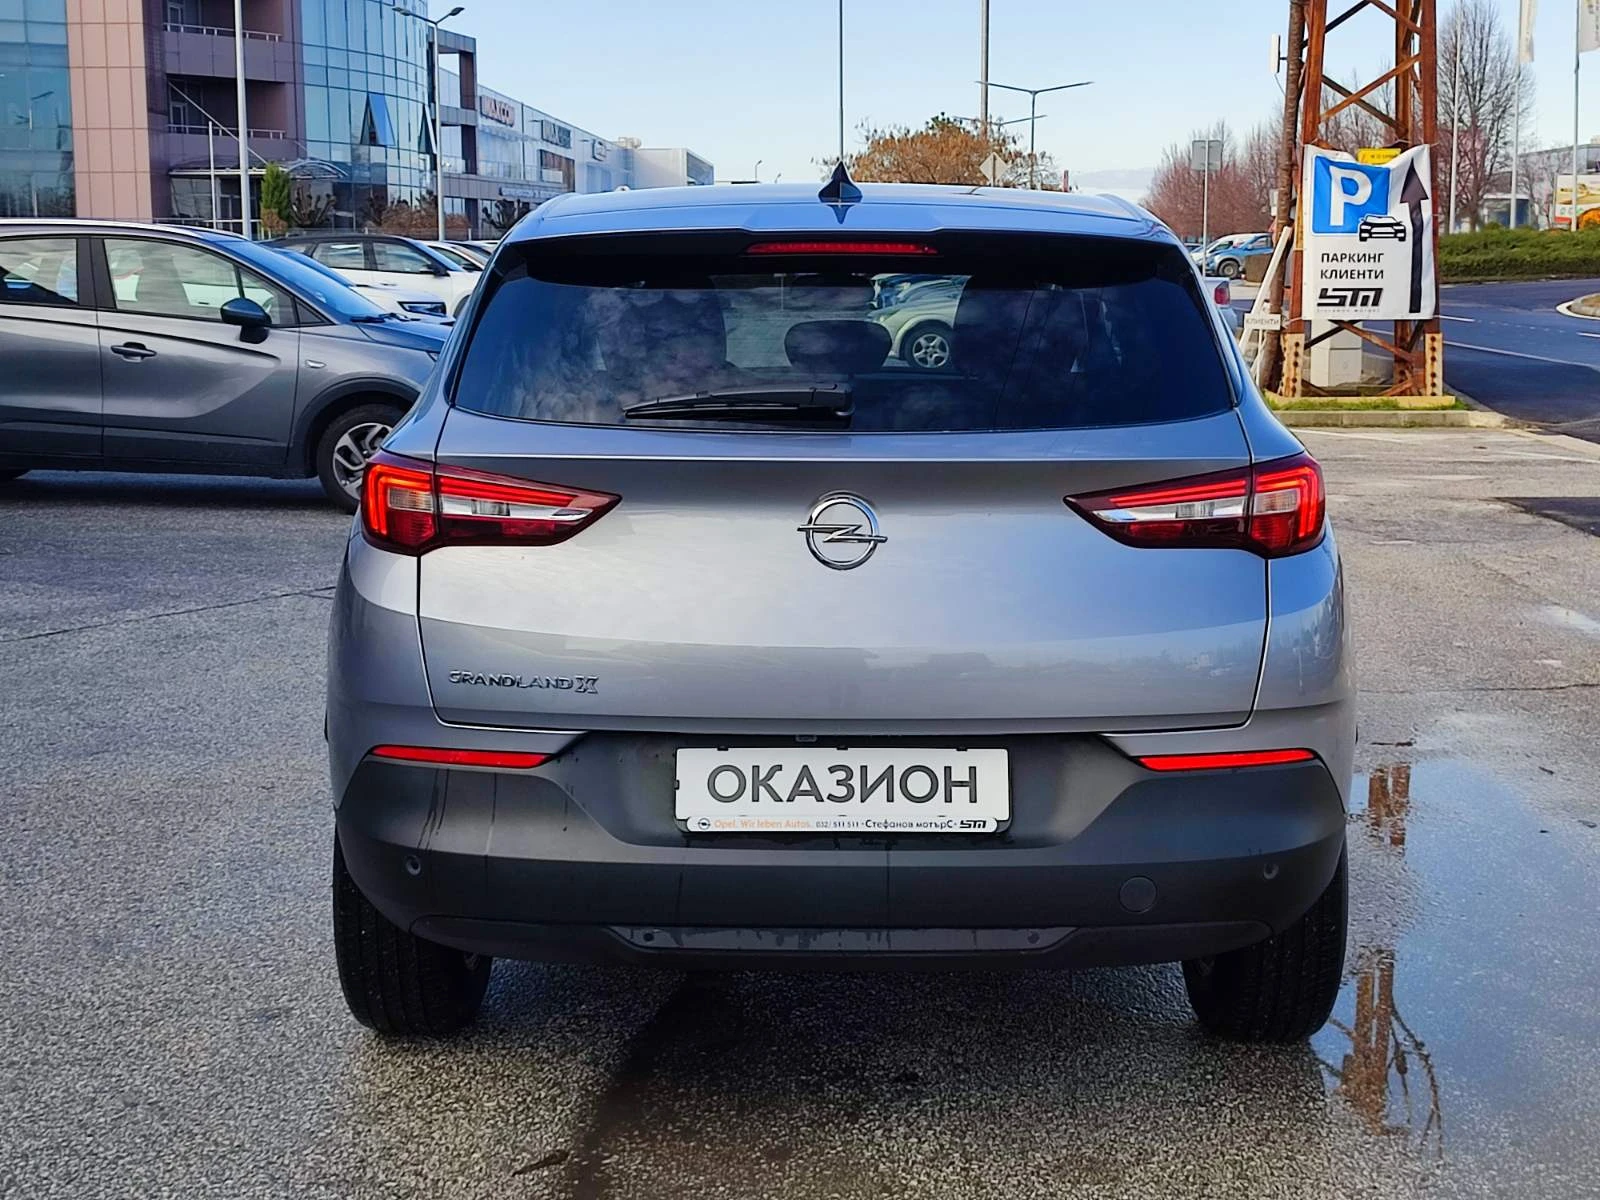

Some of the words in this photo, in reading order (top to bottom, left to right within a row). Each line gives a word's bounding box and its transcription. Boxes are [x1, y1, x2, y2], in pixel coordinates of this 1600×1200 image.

[1330, 165, 1372, 226] P
[1321, 252, 1385, 264] ПАРКИНГ
[1320, 268, 1385, 280] КЛИЕНТИ
[448, 670, 573, 689] GRANDLAND
[574, 675, 599, 694] X
[707, 764, 977, 804] ОКАЗИОН
[757, 818, 783, 829] leben
